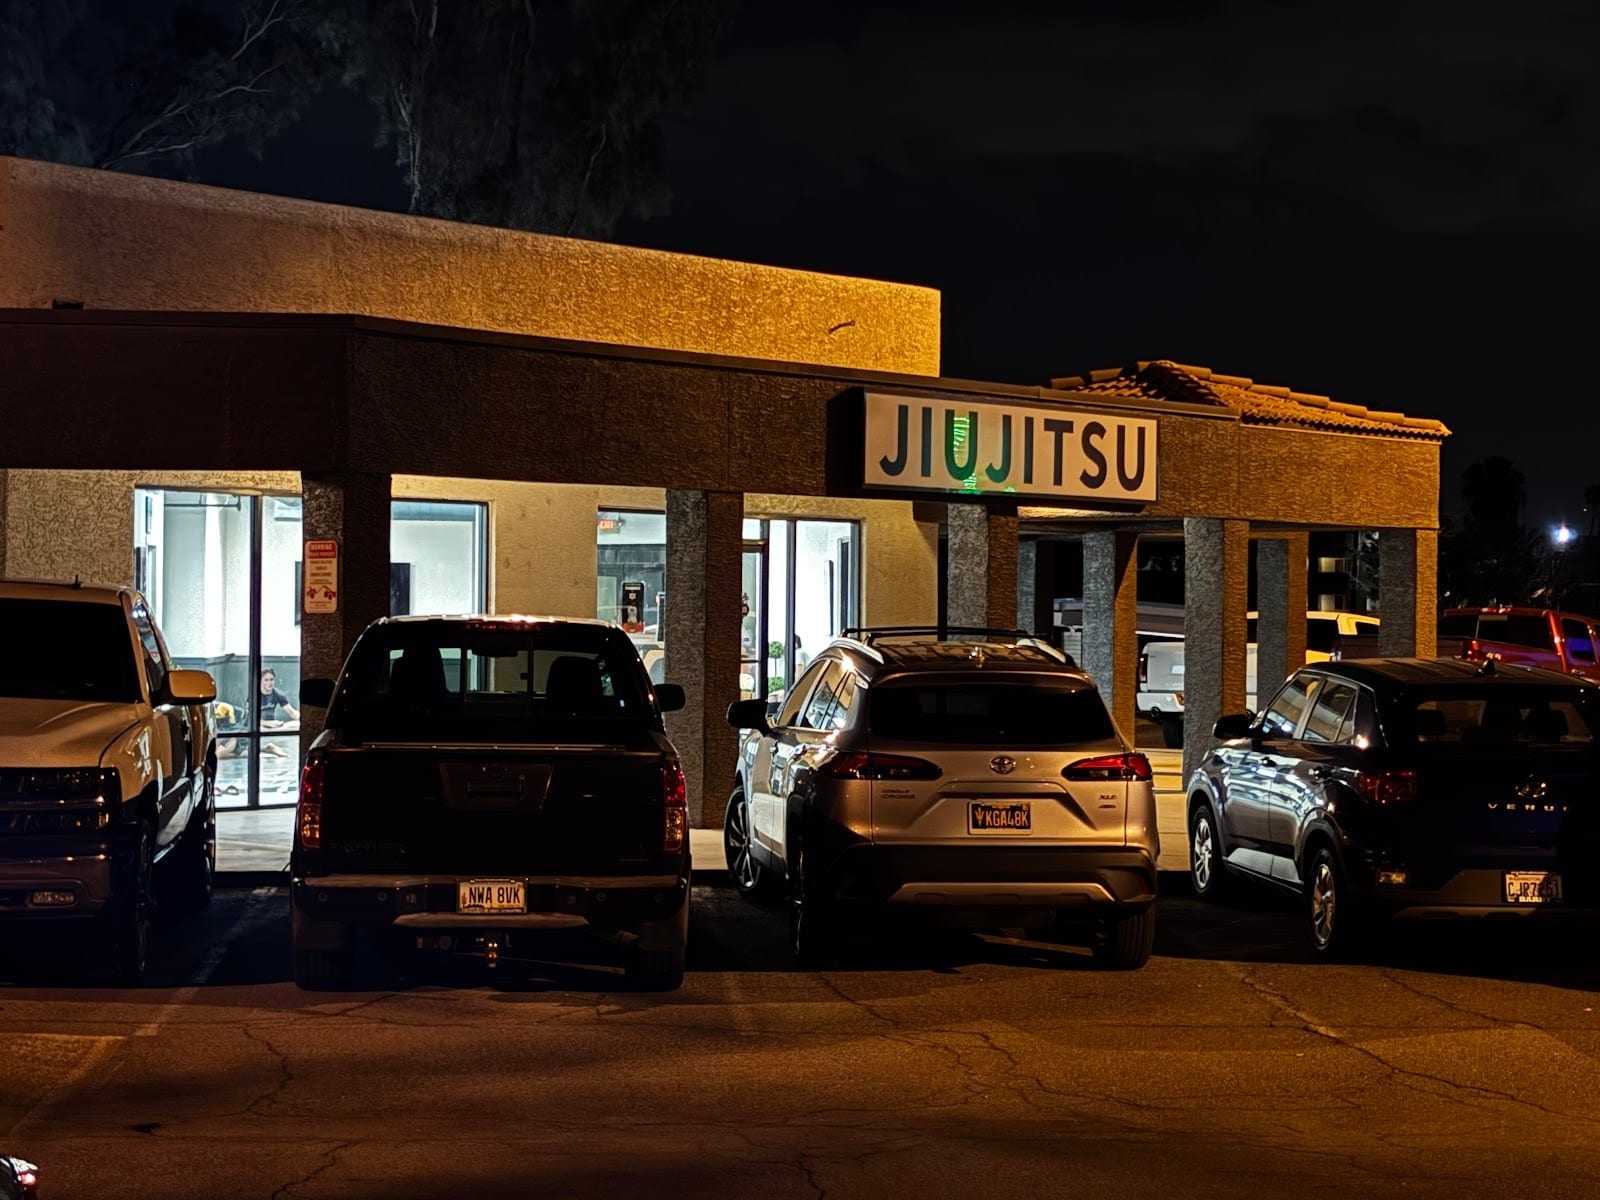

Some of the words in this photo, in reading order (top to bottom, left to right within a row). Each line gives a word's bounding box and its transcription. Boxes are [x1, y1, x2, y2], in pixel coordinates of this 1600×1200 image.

[1487, 803, 1567, 812] VENU
[985, 810, 1029, 827] KGA48K
[469, 886, 493, 904] NWA
[497, 886, 521, 904] 8VK
